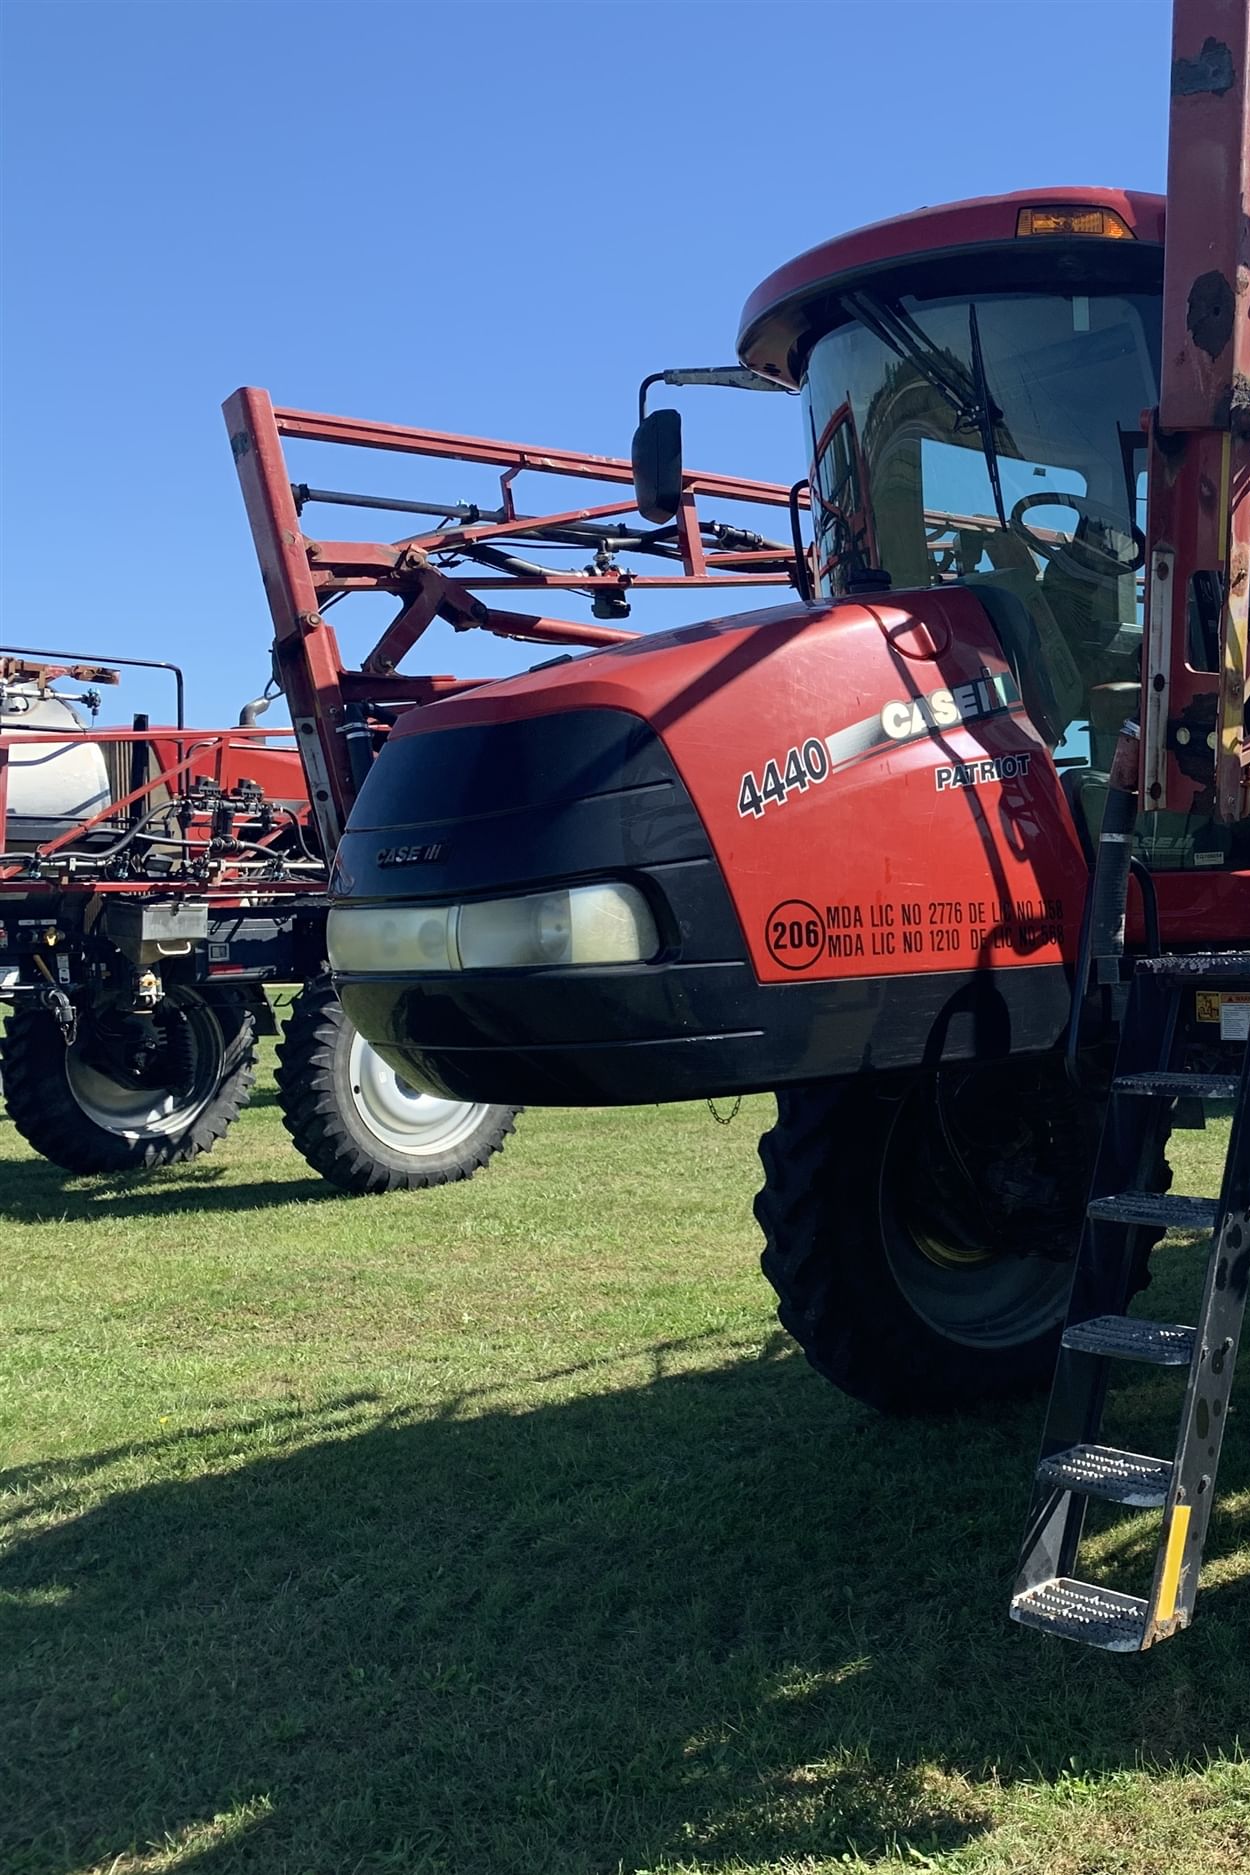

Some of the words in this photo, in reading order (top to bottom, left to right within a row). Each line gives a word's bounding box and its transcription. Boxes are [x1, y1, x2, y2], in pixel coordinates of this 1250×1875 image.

[881, 685, 978, 740] CASE
[737, 737, 829, 819] 4440
[935, 753, 1031, 792] PATRIOT
[376, 846, 422, 864] CASE
[826, 905, 864, 929] MDA
[870, 904, 894, 928] LIC
[901, 903, 922, 926] NO
[929, 901, 963, 925] 2776
[969, 901, 985, 924] DE
[992, 900, 1012, 923] LIC
[1016, 900, 1034, 921] NO
[1038, 899, 1064, 921] 1158
[772, 920, 819, 950] 206
[828, 932, 865, 958] MDA
[871, 931, 895, 956] LIC
[903, 930, 923, 955] NO
[929, 928, 960, 952] 1210
[970, 927, 987, 949] DE
[993, 926, 1013, 948] LIC
[1018, 925, 1036, 947] NO
